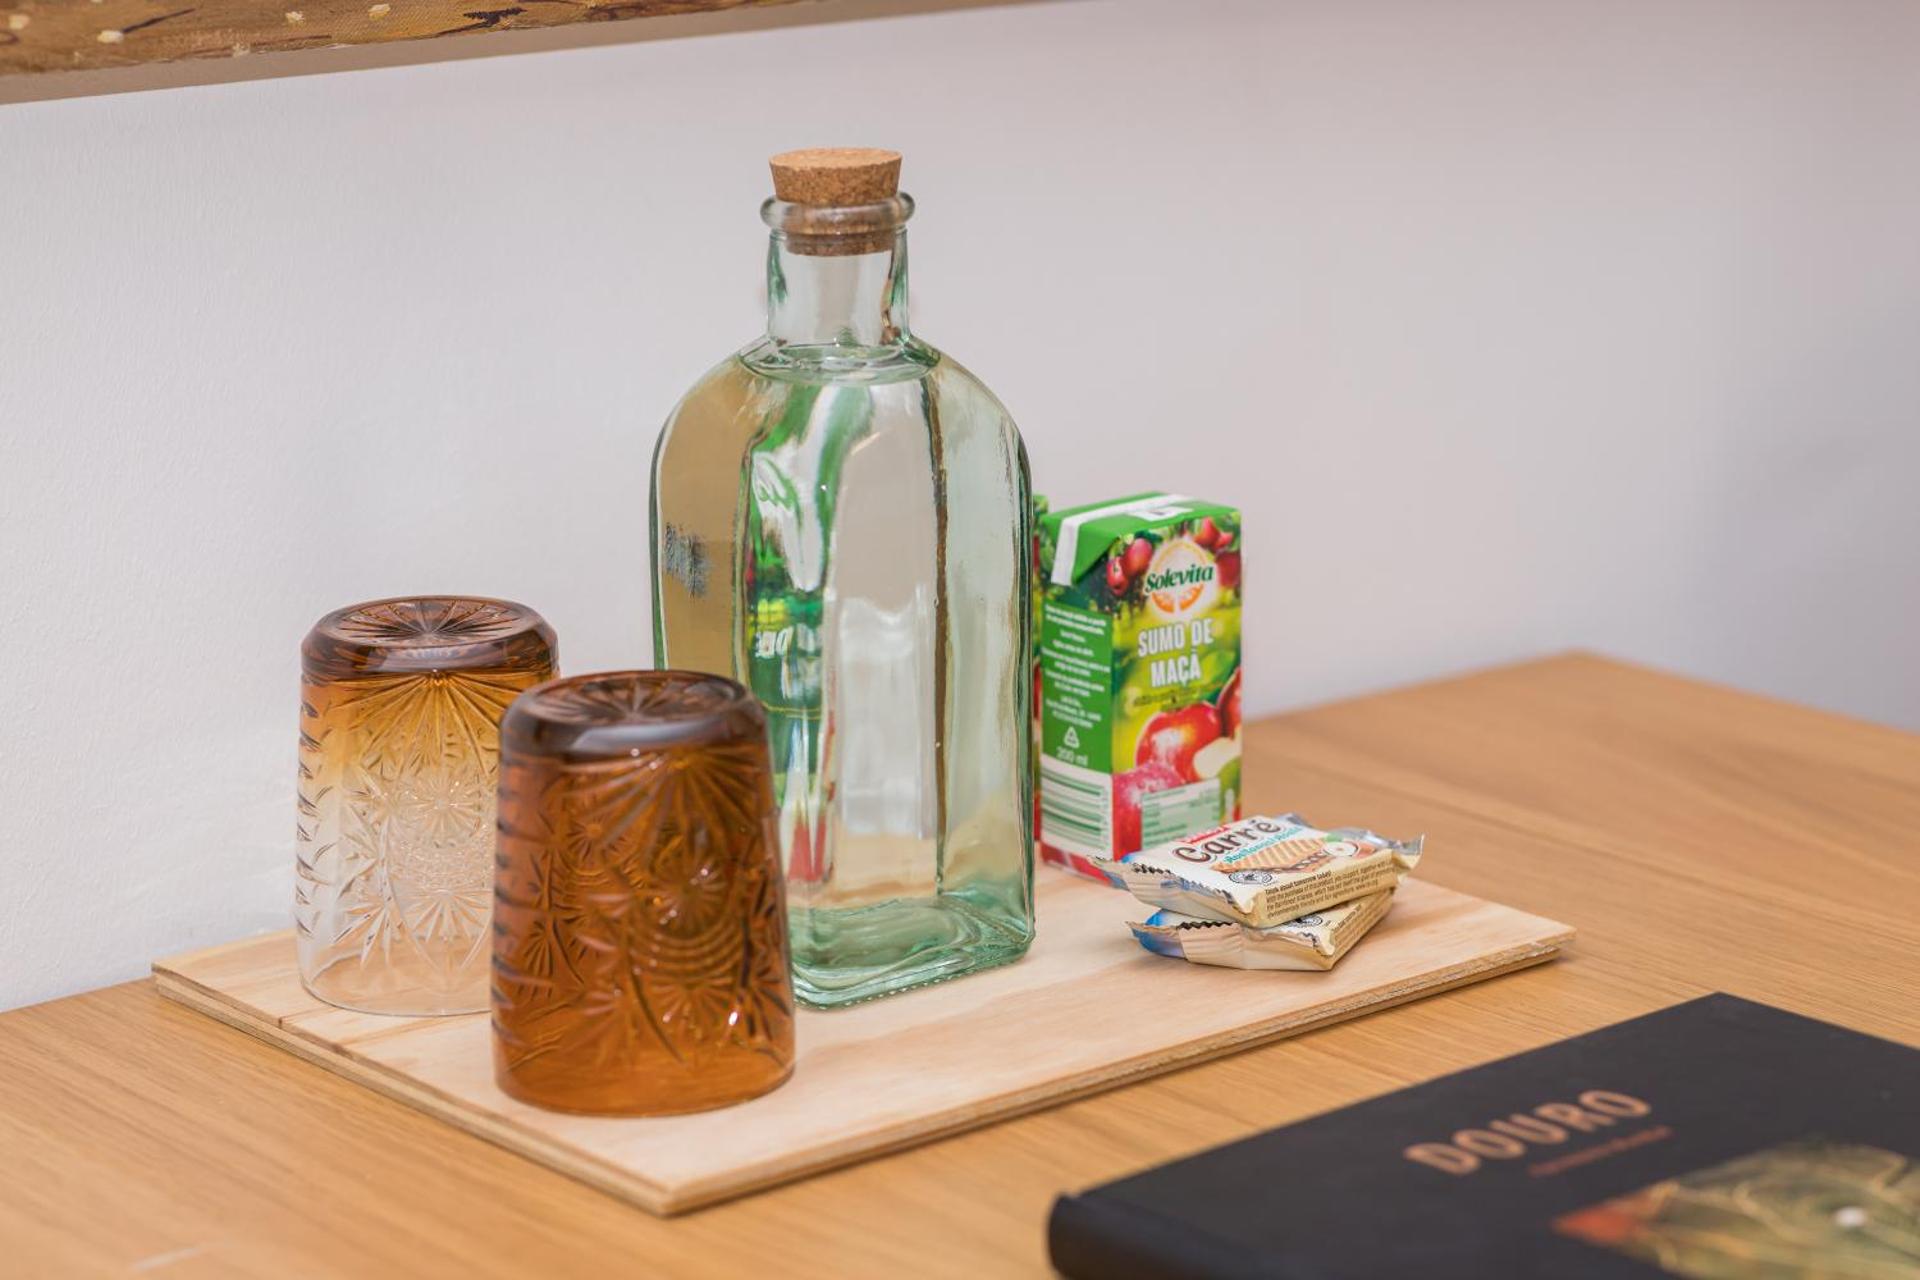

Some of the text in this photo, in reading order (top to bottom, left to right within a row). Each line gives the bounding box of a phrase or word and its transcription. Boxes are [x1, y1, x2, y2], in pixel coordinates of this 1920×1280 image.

[1144, 564, 1214, 593] Solevita
[1138, 623, 1185, 657] SUMO
[1191, 618, 1213, 646] DE
[1151, 645, 1201, 687] MAÇÃ
[1173, 819, 1281, 863] Carré
[1403, 1090, 1651, 1175] DOURO
